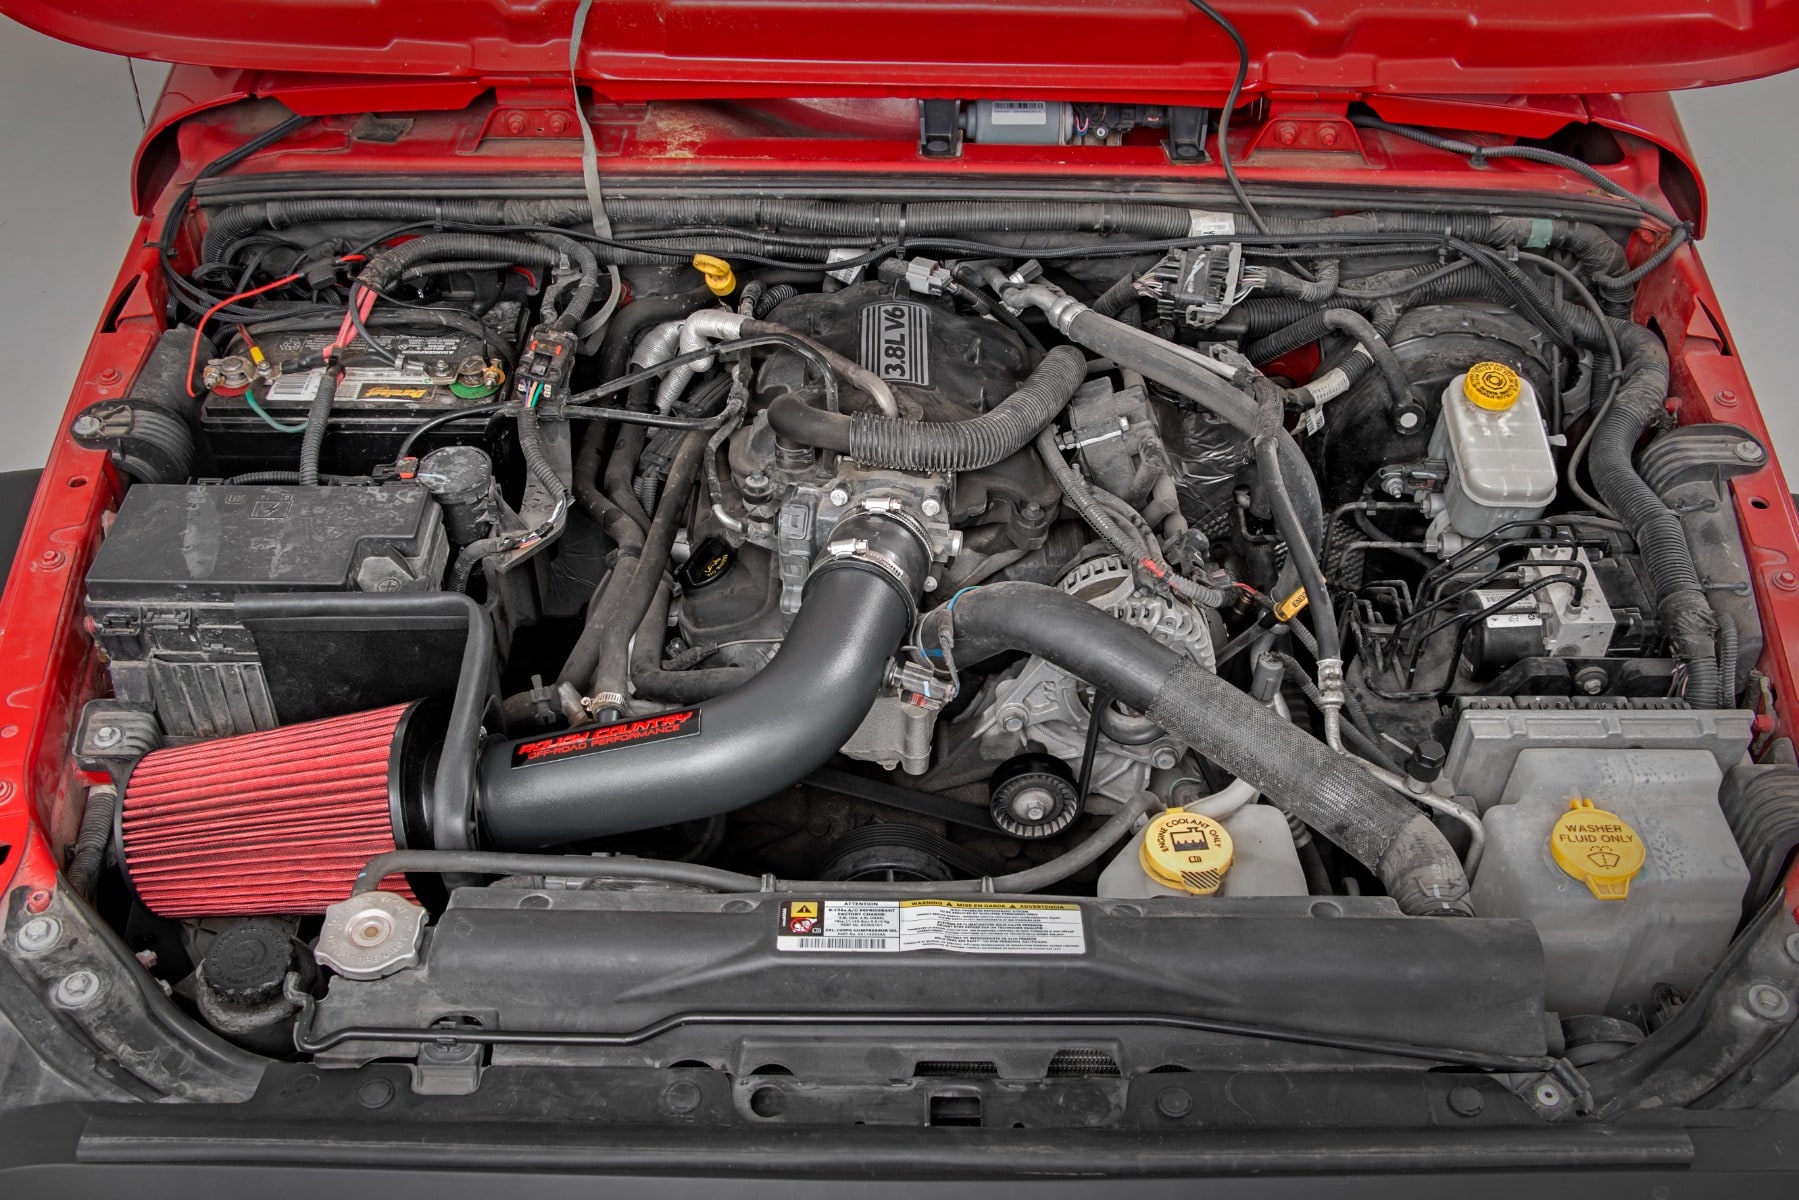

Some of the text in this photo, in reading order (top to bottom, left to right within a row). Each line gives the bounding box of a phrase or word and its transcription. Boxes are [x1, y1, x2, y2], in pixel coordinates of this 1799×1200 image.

[883, 306, 905, 377] 3.8L V6
[364, 388, 426, 398] Duralast
[518, 712, 693, 755] ROUGH COUNTRY
[528, 724, 681, 760] OFF-ROAD PERFORMANCE
[1157, 818, 1222, 852] ENGINE COOLANT ONLY
[1559, 834, 1633, 843] FLUID ONLY
[1565, 824, 1622, 833] WASHER
